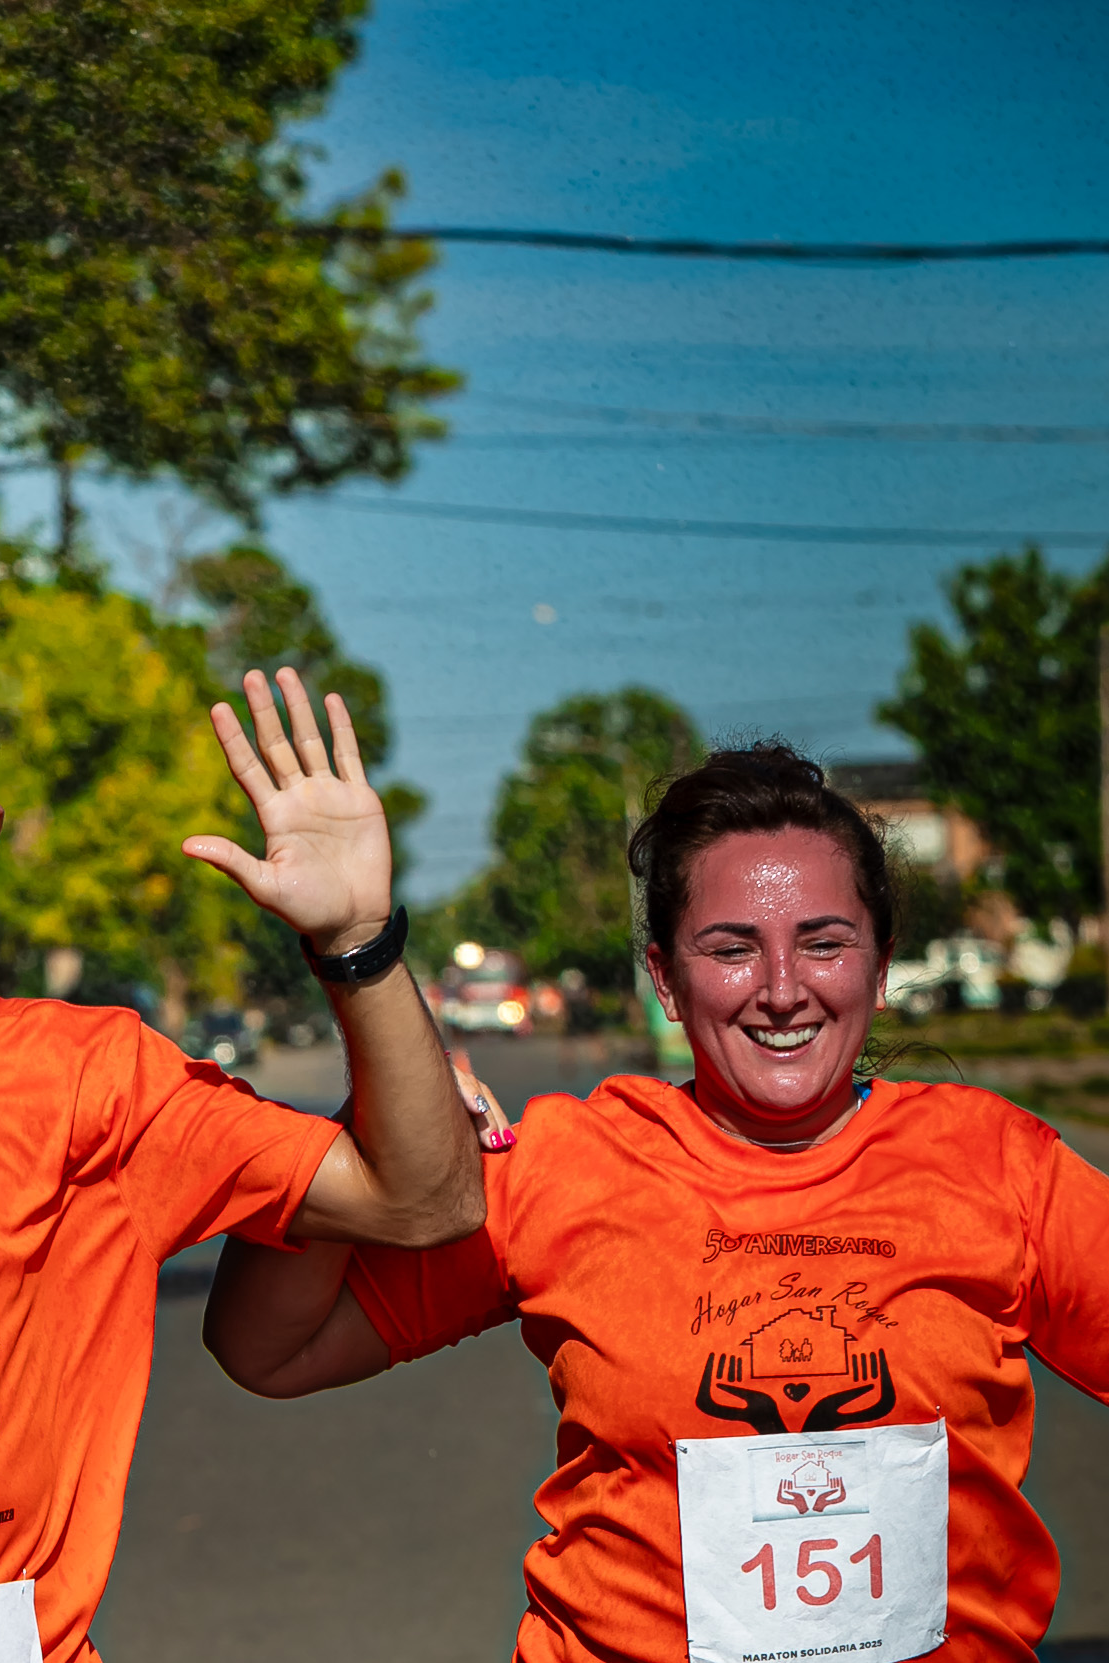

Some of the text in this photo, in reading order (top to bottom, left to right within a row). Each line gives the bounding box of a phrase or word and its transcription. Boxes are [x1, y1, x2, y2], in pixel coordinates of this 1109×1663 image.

[745, 1233, 896, 1259] ANIVERSARIO
[691, 1291, 761, 1335] Hogar
[770, 1272, 823, 1301] San
[775, 1449, 843, 1463] Hogar San Roque
[741, 1533, 883, 1610] 151
[743, 1639, 883, 1662] MARATON SOLIDARIA 2025
